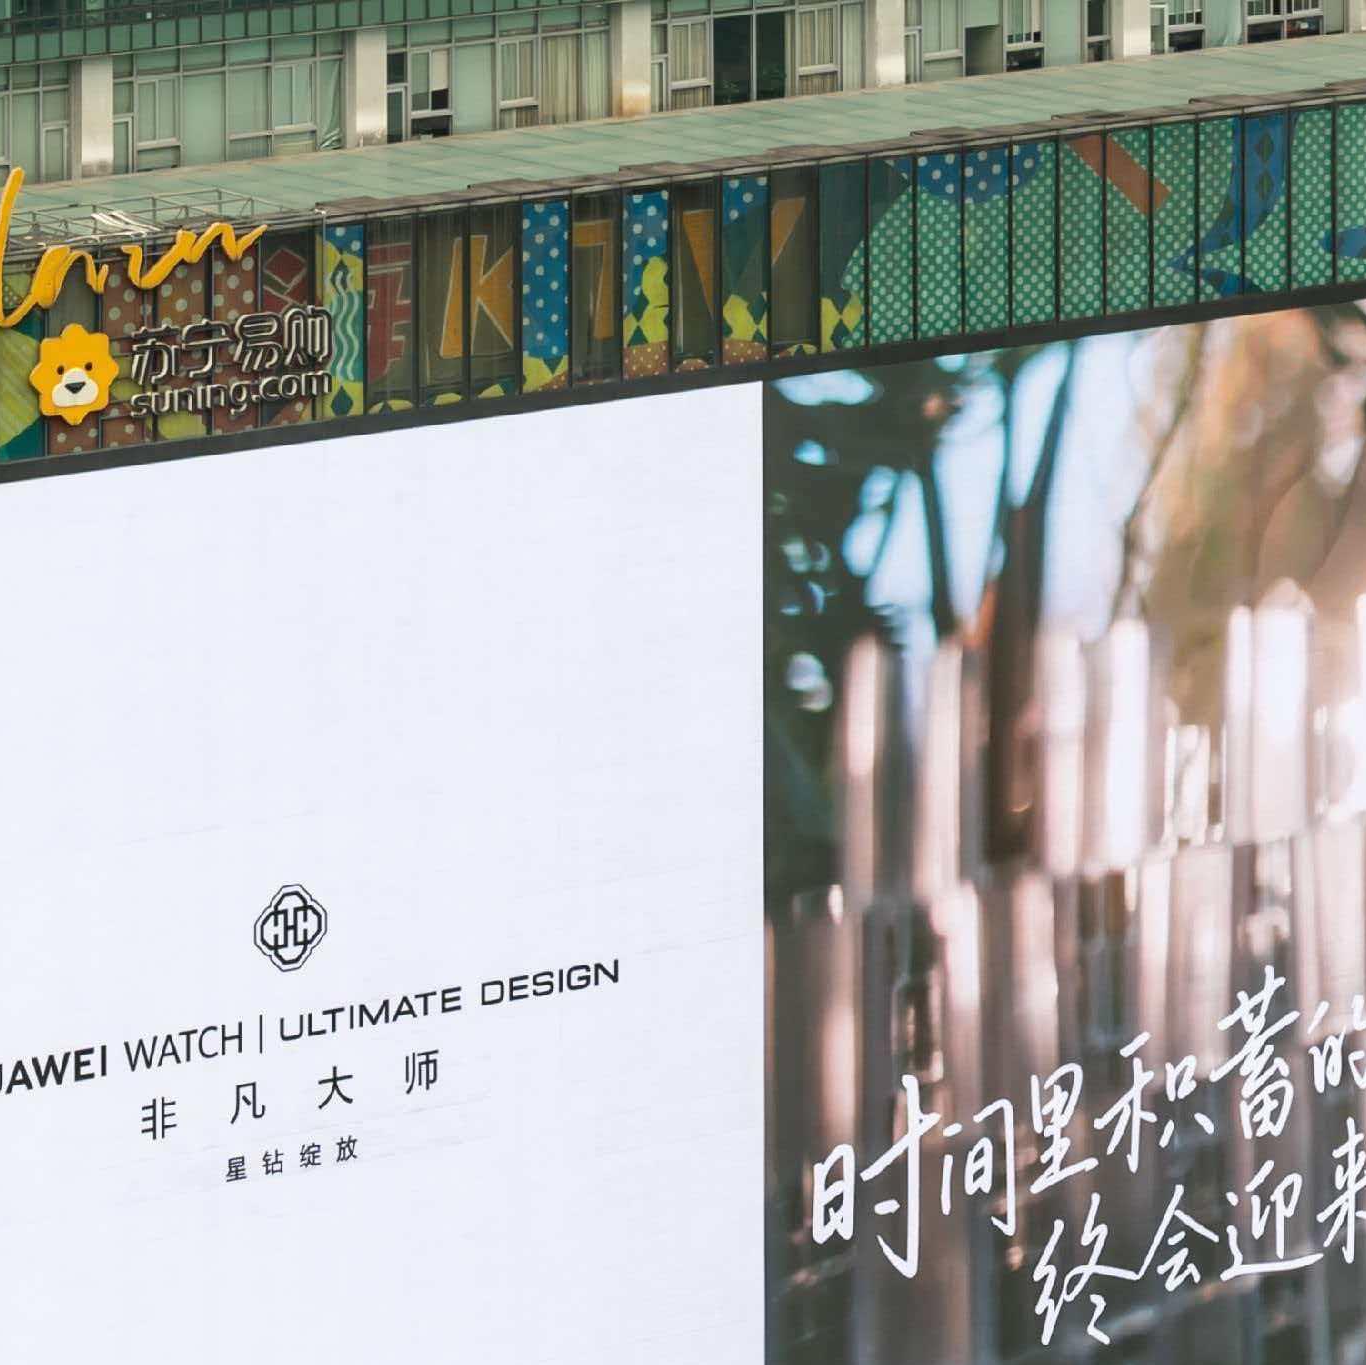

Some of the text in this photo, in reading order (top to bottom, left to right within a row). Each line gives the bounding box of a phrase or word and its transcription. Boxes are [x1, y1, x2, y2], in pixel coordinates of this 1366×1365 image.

[130, 304, 333, 386] 苏宁易购
[130, 367, 333, 421] suning.com
[123, 1022, 243, 1072] WATCH
[279, 986, 462, 1042] ULTIMATE
[480, 959, 619, 1006] DESIGN
[140, 1049, 439, 1140] 非凡大师
[225, 1136, 359, 1183] 星钻绽放
